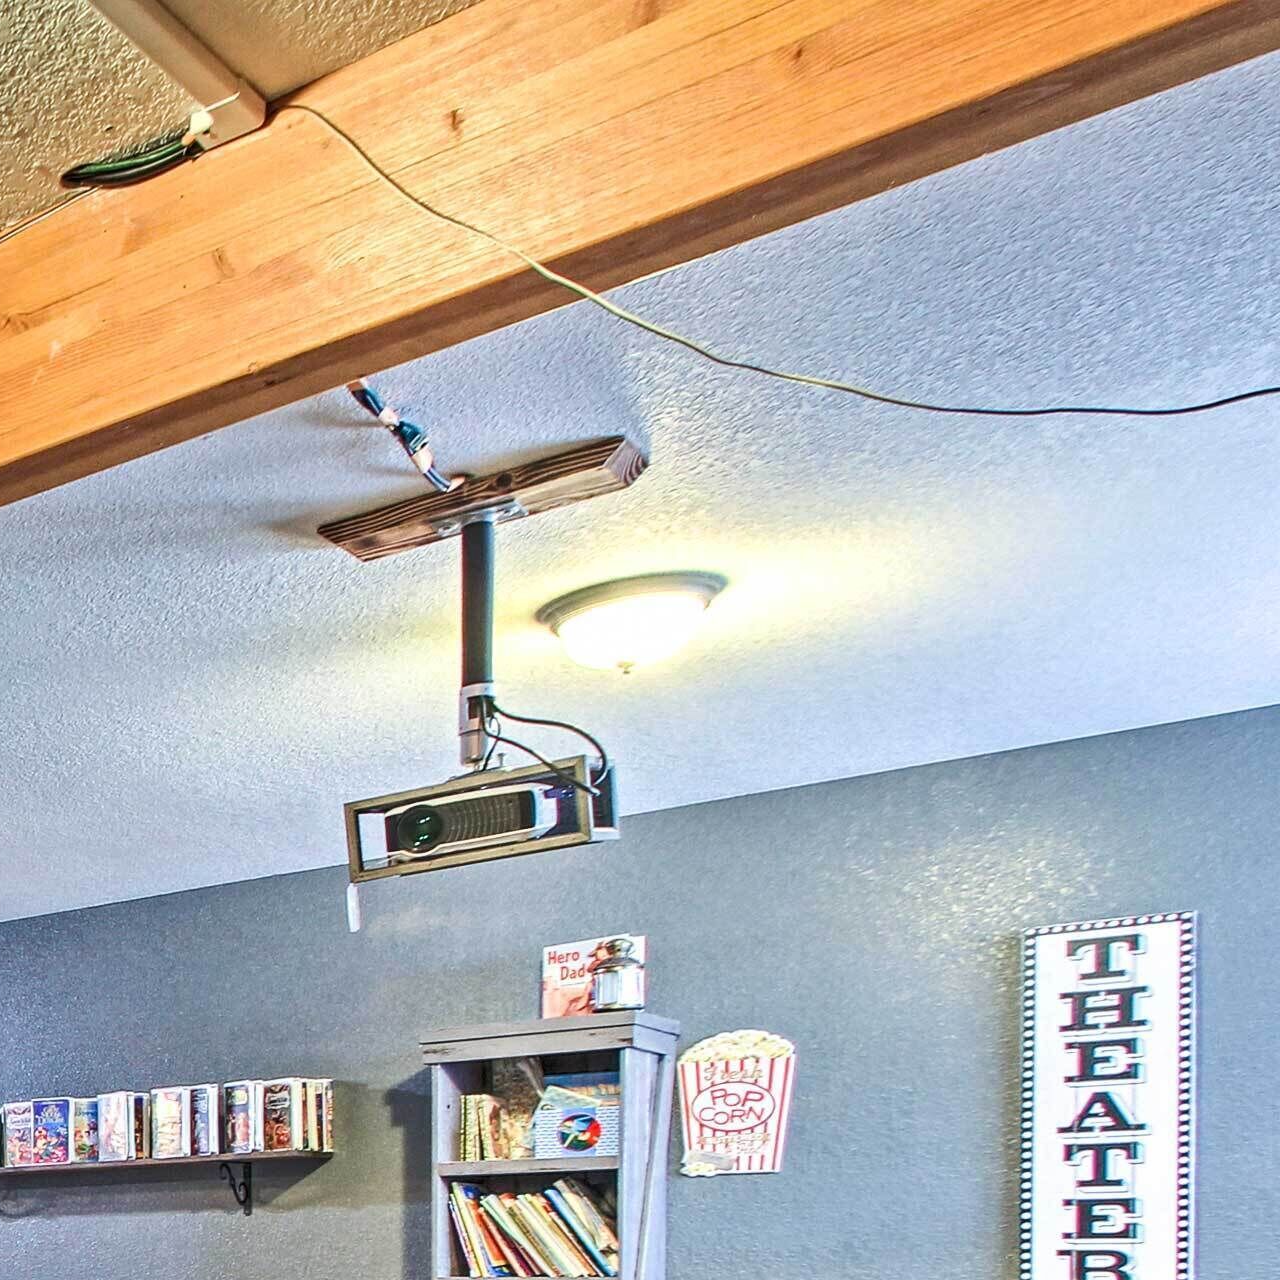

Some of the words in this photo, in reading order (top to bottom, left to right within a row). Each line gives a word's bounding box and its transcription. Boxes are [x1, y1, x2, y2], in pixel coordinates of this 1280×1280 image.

[547, 950, 580, 965] Hero
[560, 963, 586, 981] Dad
[710, 1088, 764, 1107] POP
[699, 1106, 765, 1125] CORN
